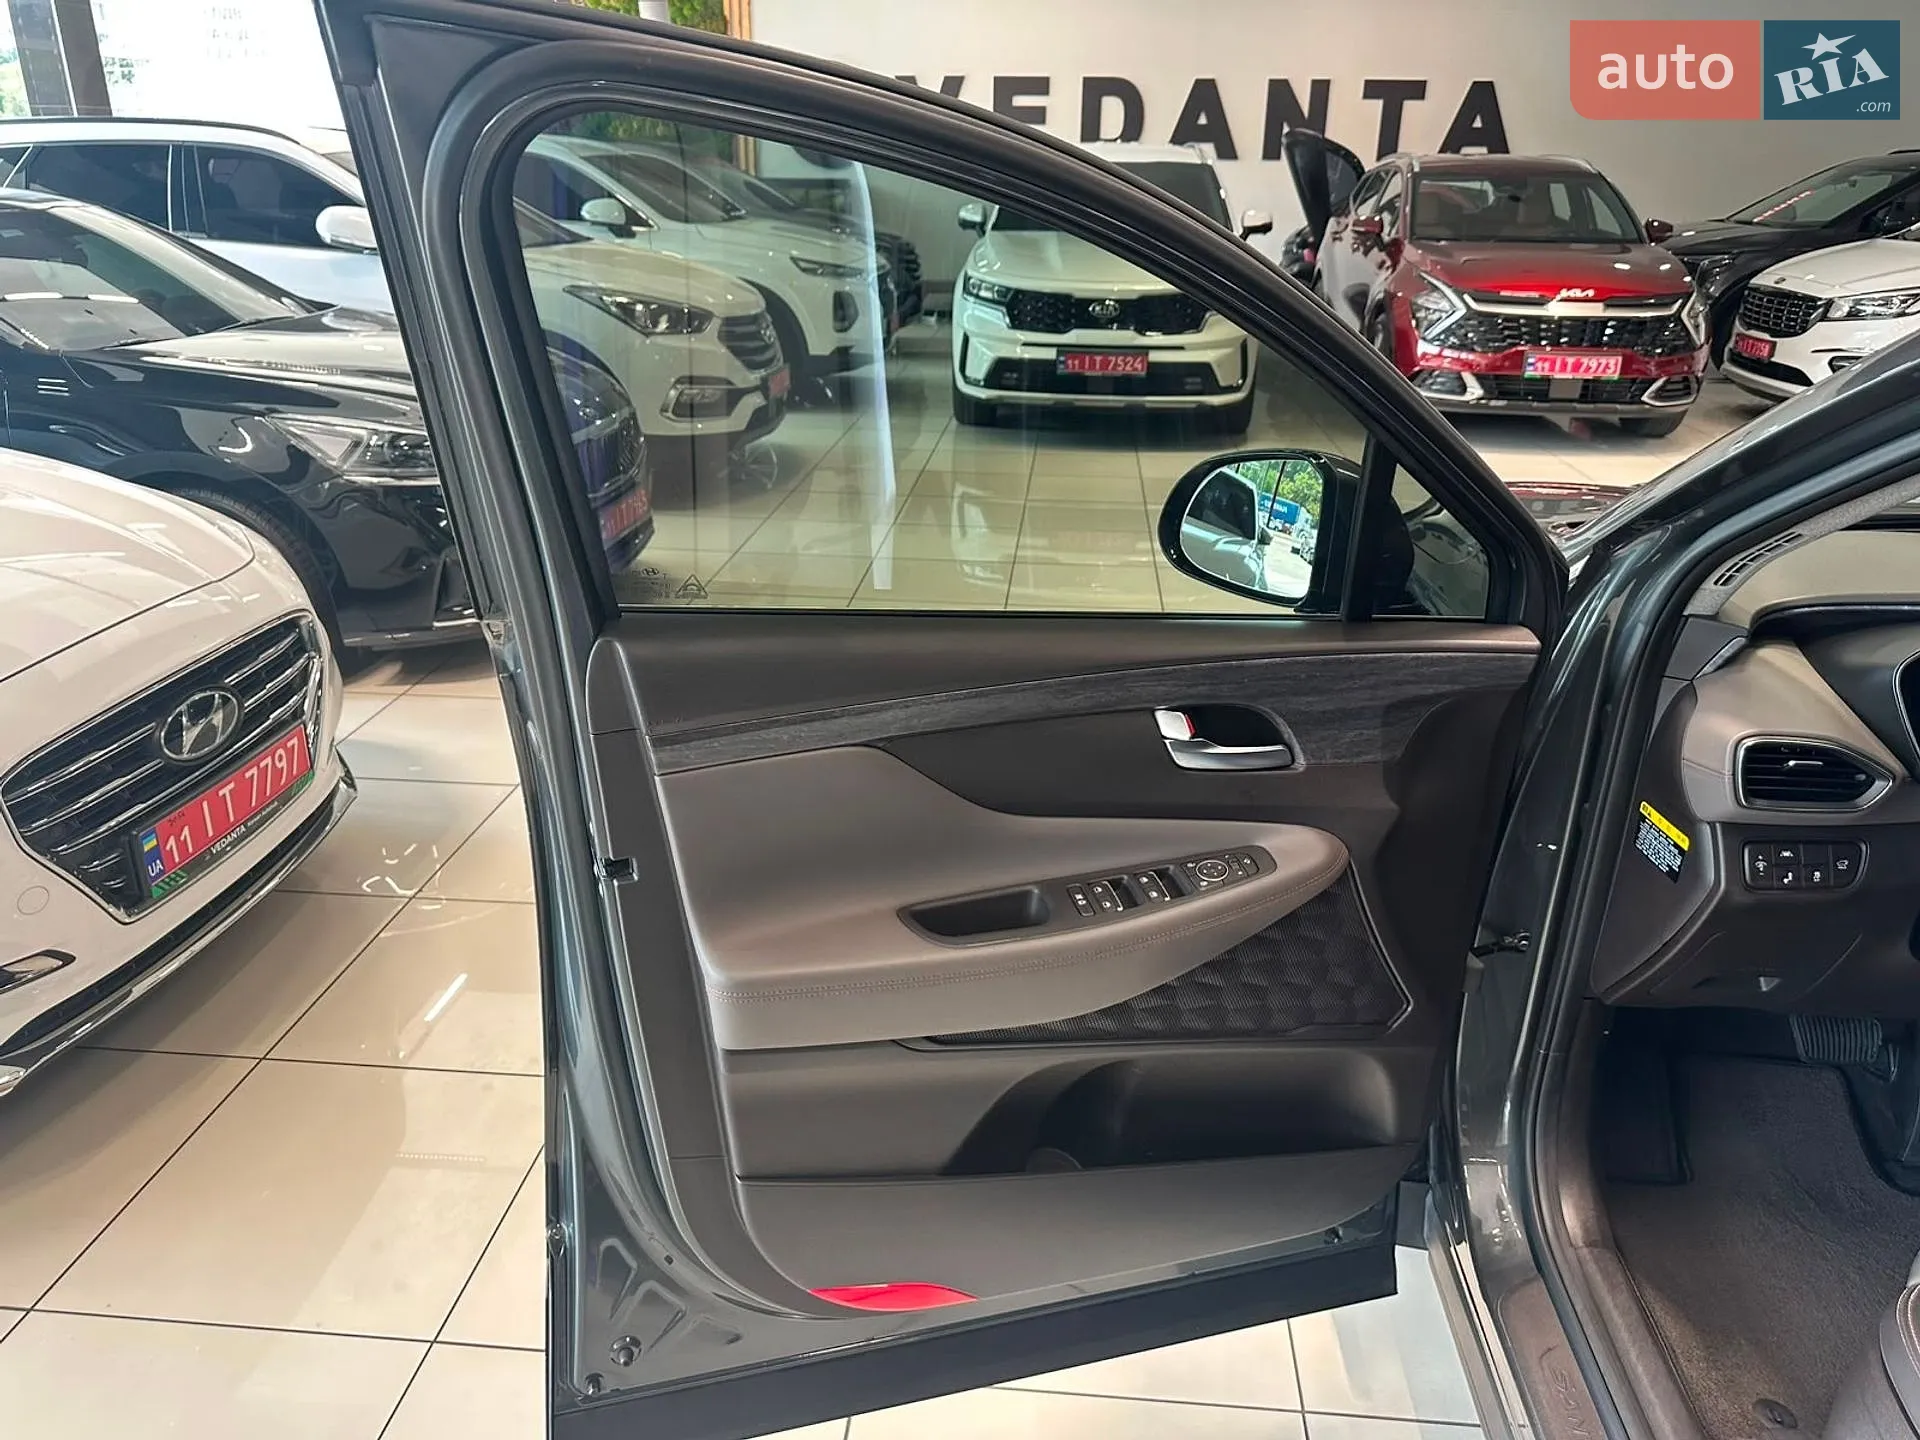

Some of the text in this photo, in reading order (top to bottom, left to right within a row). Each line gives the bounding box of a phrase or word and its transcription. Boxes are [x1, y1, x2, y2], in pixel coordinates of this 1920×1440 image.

[1107, 356, 1143, 371] 7524
[1579, 358, 1617, 372] 7973
[165, 824, 194, 863] 11
[244, 736, 300, 808] 7797
[210, 825, 248, 855] VEDANTA
[147, 859, 164, 877] UA
